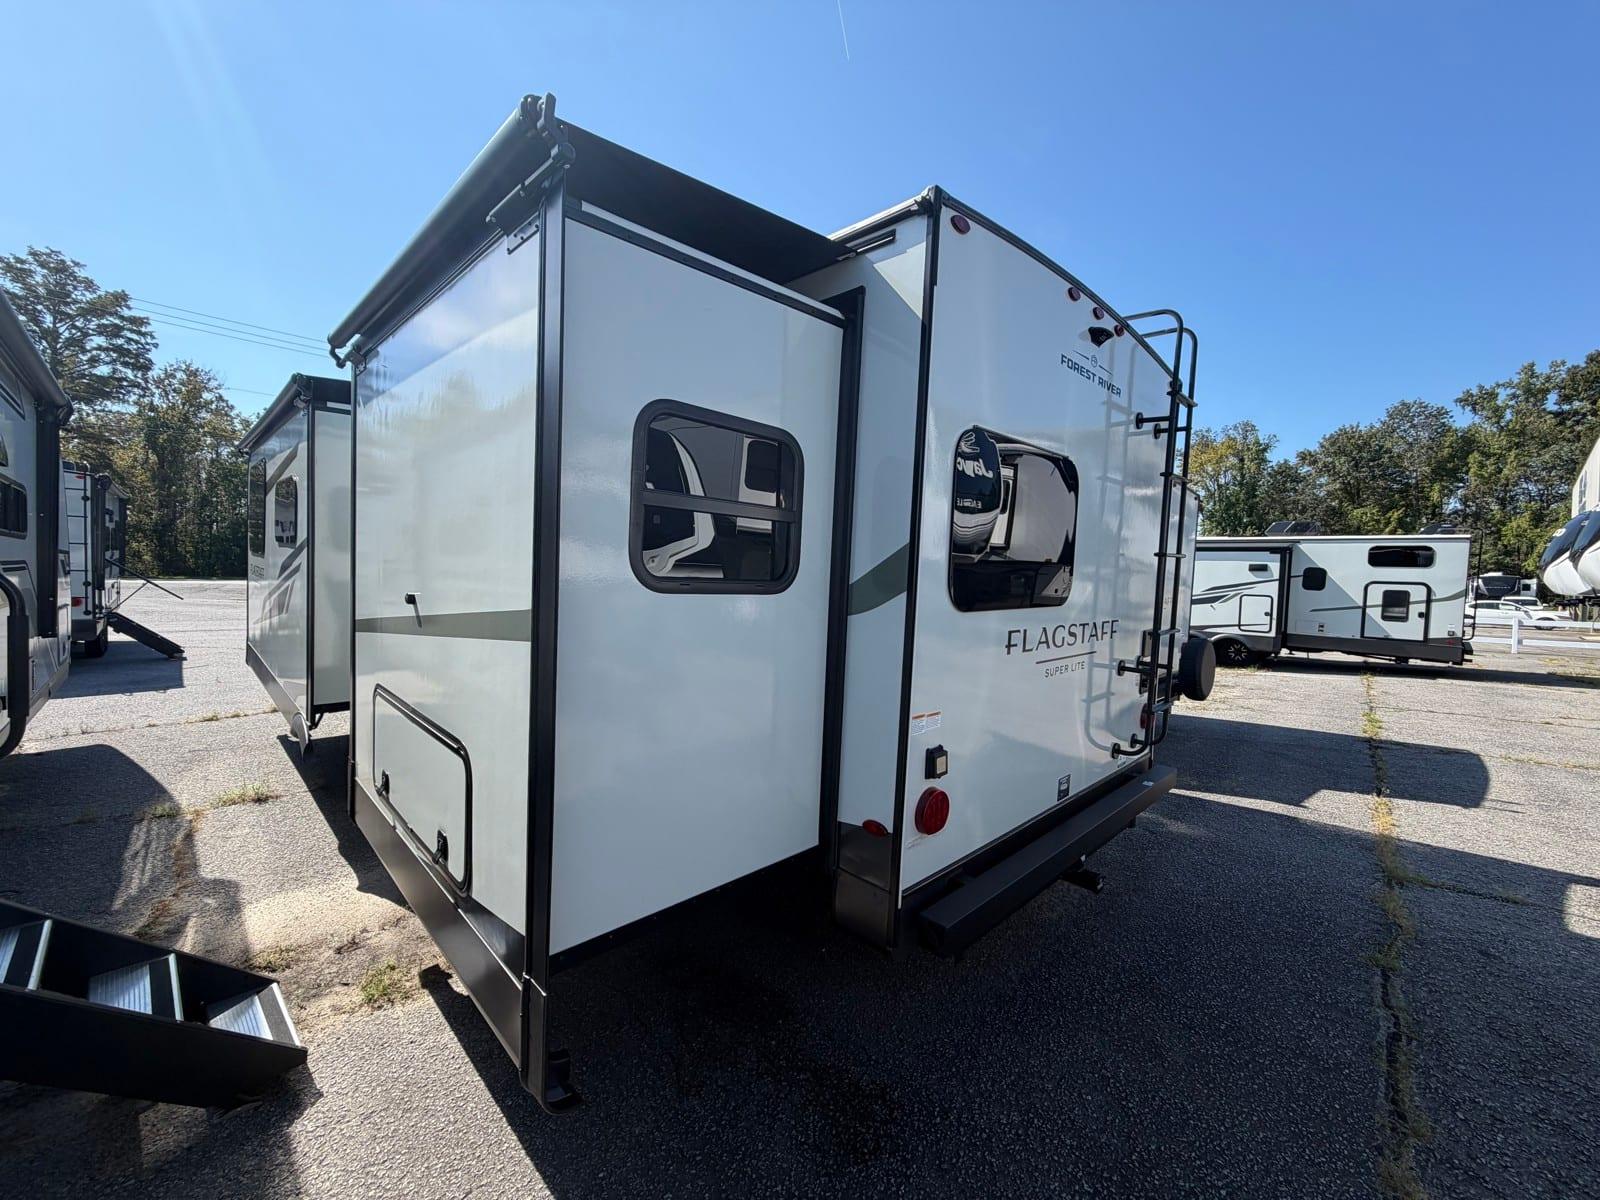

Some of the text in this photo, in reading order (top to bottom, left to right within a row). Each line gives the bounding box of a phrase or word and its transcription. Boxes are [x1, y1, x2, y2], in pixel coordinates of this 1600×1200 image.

[1060, 353, 1122, 398] FOREST RIVER
[1005, 619, 1119, 655] FLAGSTAFF
[1044, 660, 1085, 678] SUPER LITE
